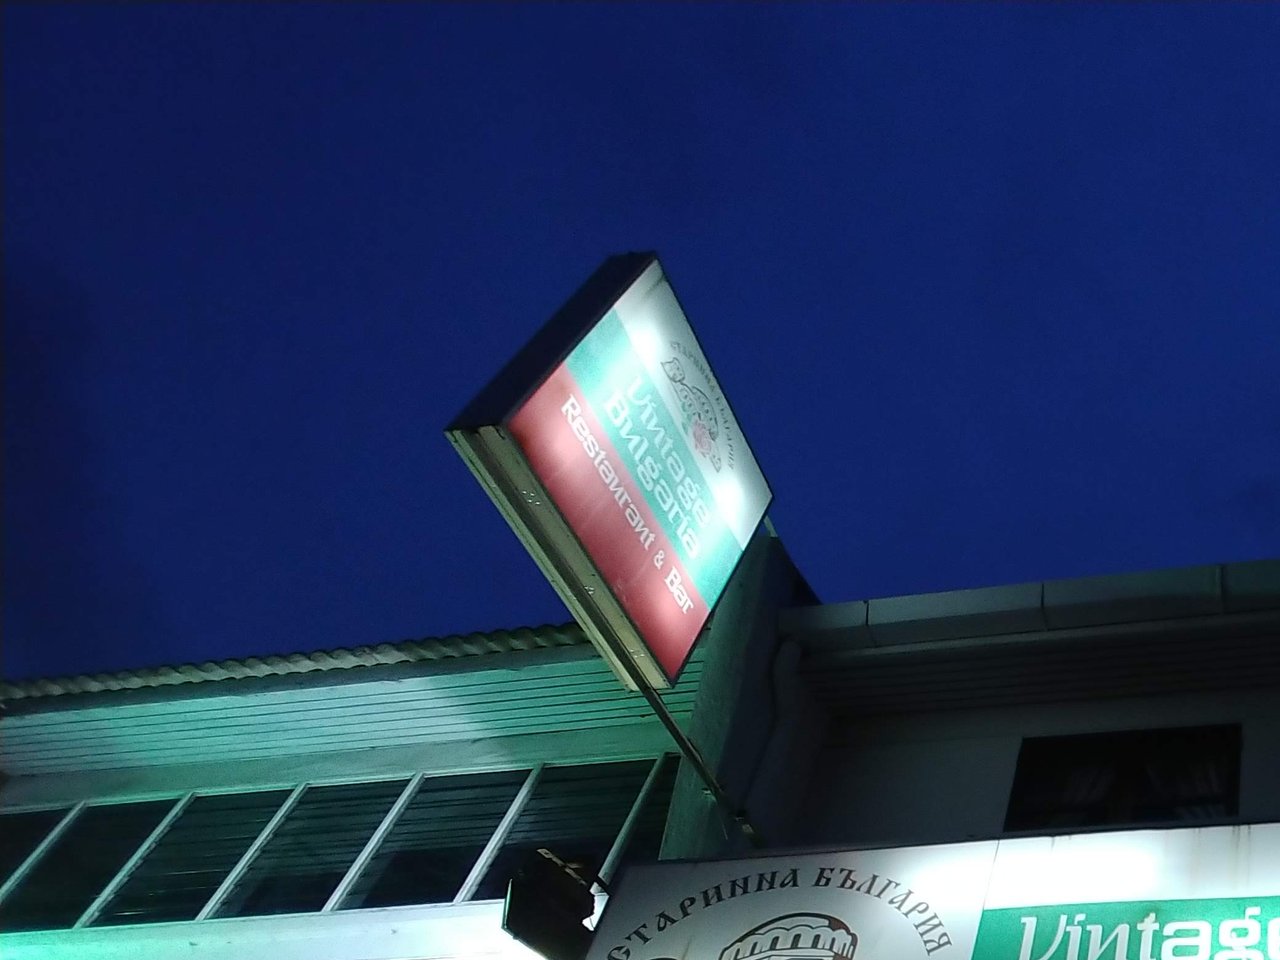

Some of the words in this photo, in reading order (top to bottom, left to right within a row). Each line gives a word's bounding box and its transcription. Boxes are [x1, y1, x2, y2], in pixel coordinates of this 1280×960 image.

[560, 393, 656, 551] Restaurant
[653, 550, 665, 570] &
[664, 572, 694, 614] Bar
[604, 390, 701, 560] Bulgaria
[626, 376, 712, 528] Vintage
[811, 867, 953, 957] БЪЛГАРИЯ
